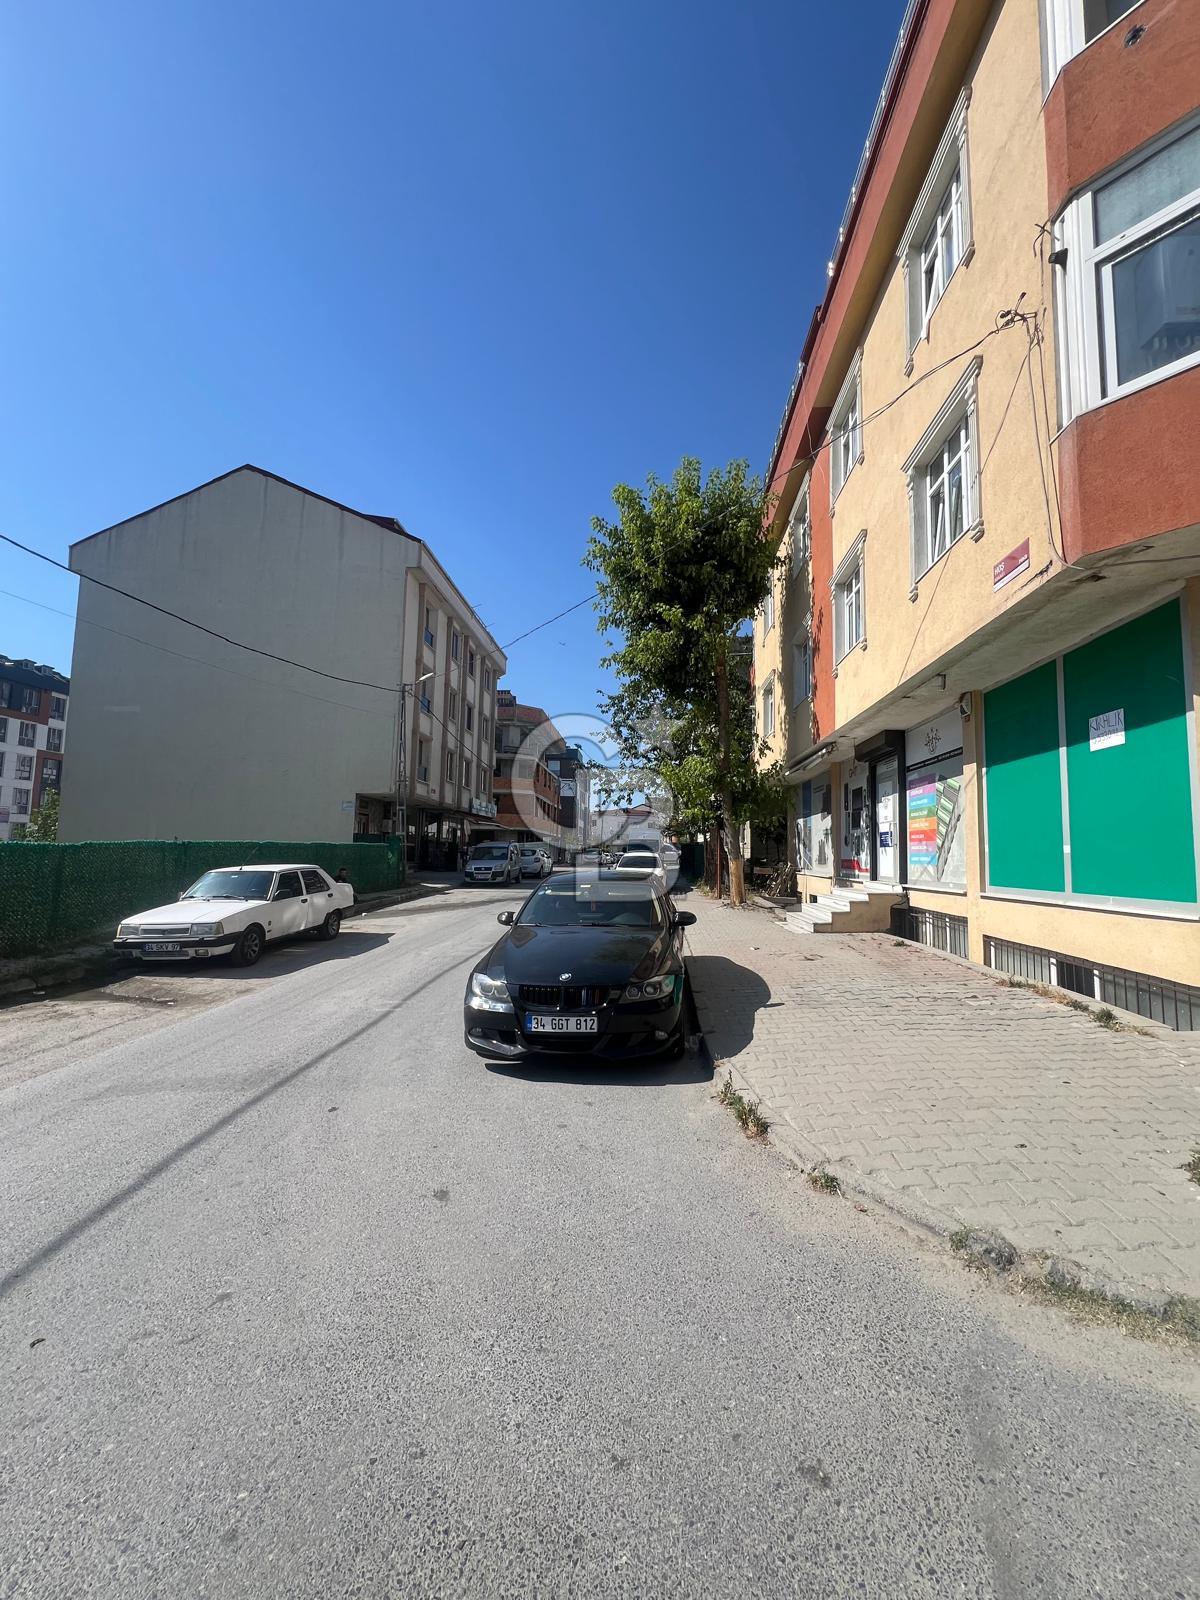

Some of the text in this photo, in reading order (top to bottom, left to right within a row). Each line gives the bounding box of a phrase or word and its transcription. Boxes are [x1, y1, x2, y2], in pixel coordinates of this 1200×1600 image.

[533, 1017, 596, 1031] 34 GGT 812
